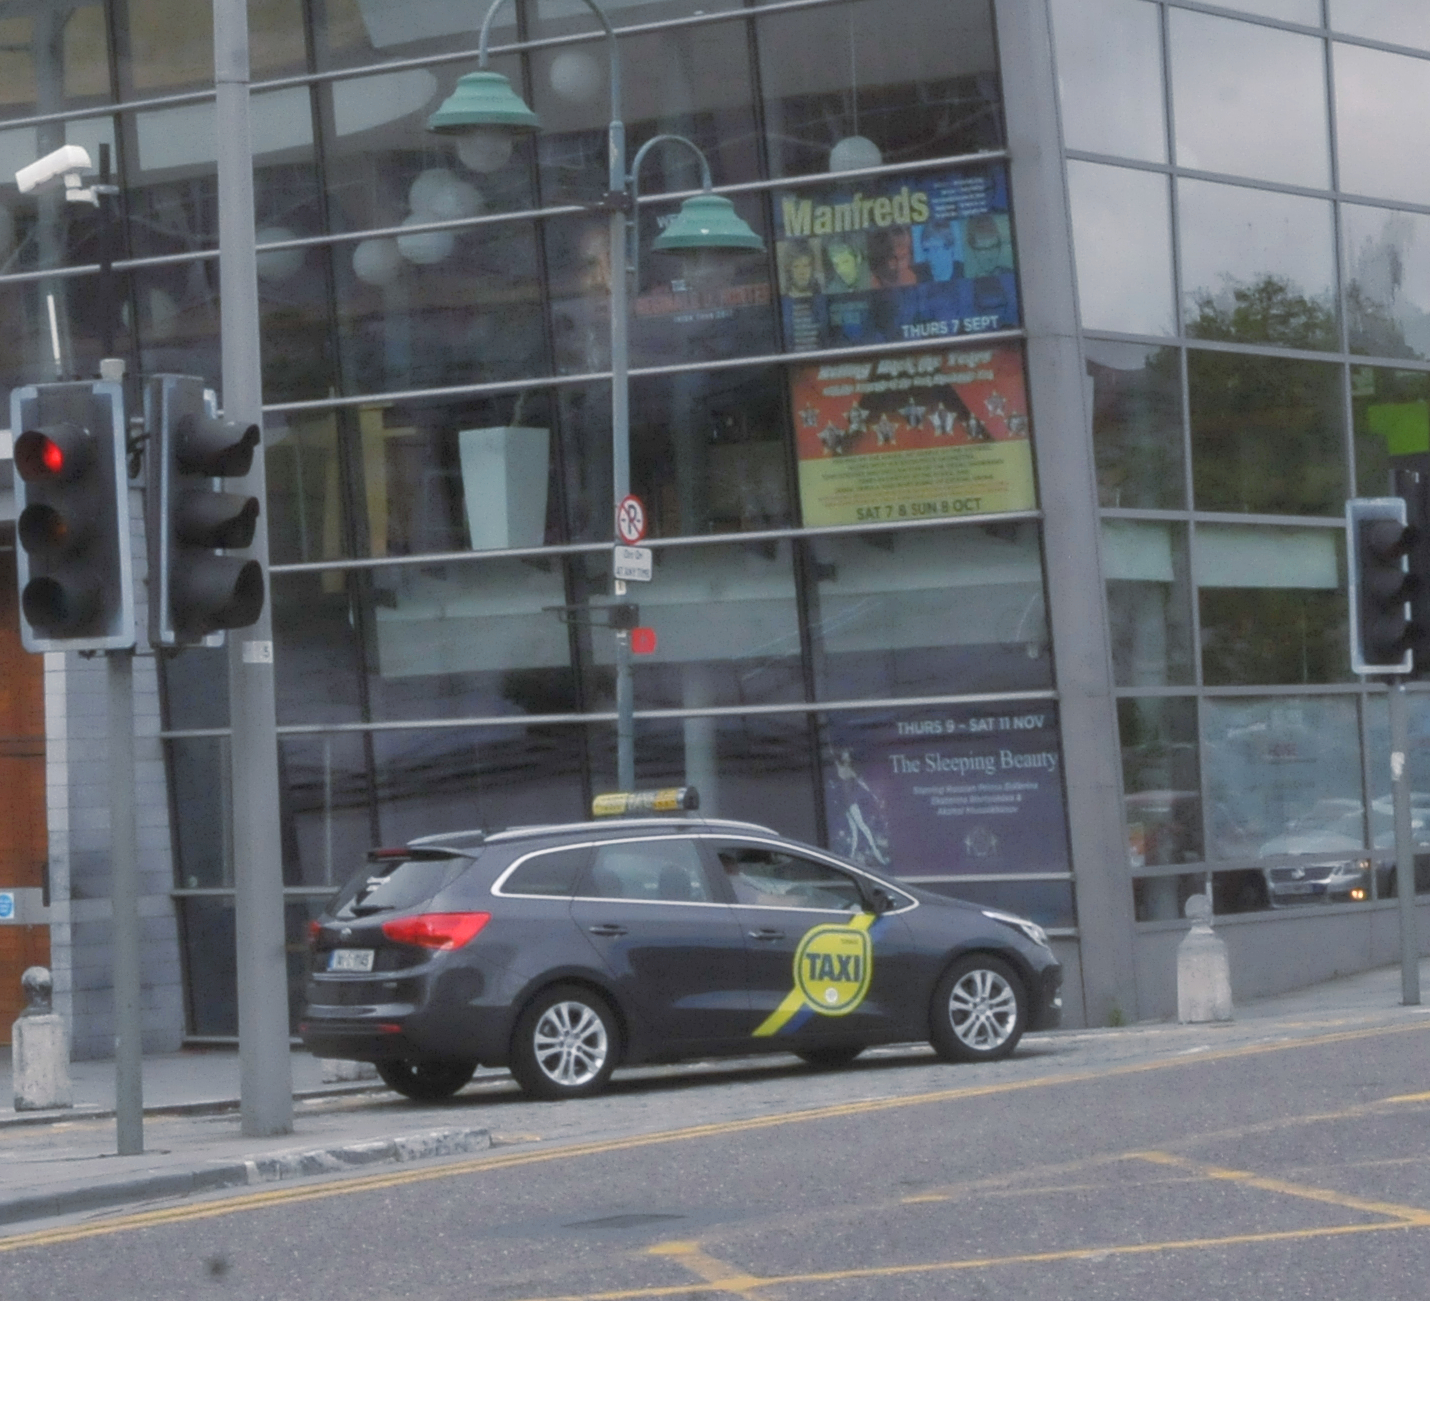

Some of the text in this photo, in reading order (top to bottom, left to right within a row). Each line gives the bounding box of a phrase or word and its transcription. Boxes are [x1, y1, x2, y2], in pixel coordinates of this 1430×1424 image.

[782, 185, 930, 238] Manfreds
[901, 314, 999, 338] THURS 7 SEPT
[856, 504, 881, 521] SAT
[885, 503, 893, 518] 7
[911, 501, 937, 516] SUN
[941, 500, 950, 514] 8
[952, 497, 982, 514] OCT
[897, 720, 942, 736] THURS
[946, 719, 955, 733] 9
[970, 717, 995, 732] SAT
[998, 717, 1011, 731] 11
[1013, 714, 1045, 730] NOV
[889, 748, 1059, 776] The Sleeping Beauty
[806, 952, 860, 983] TAXI
